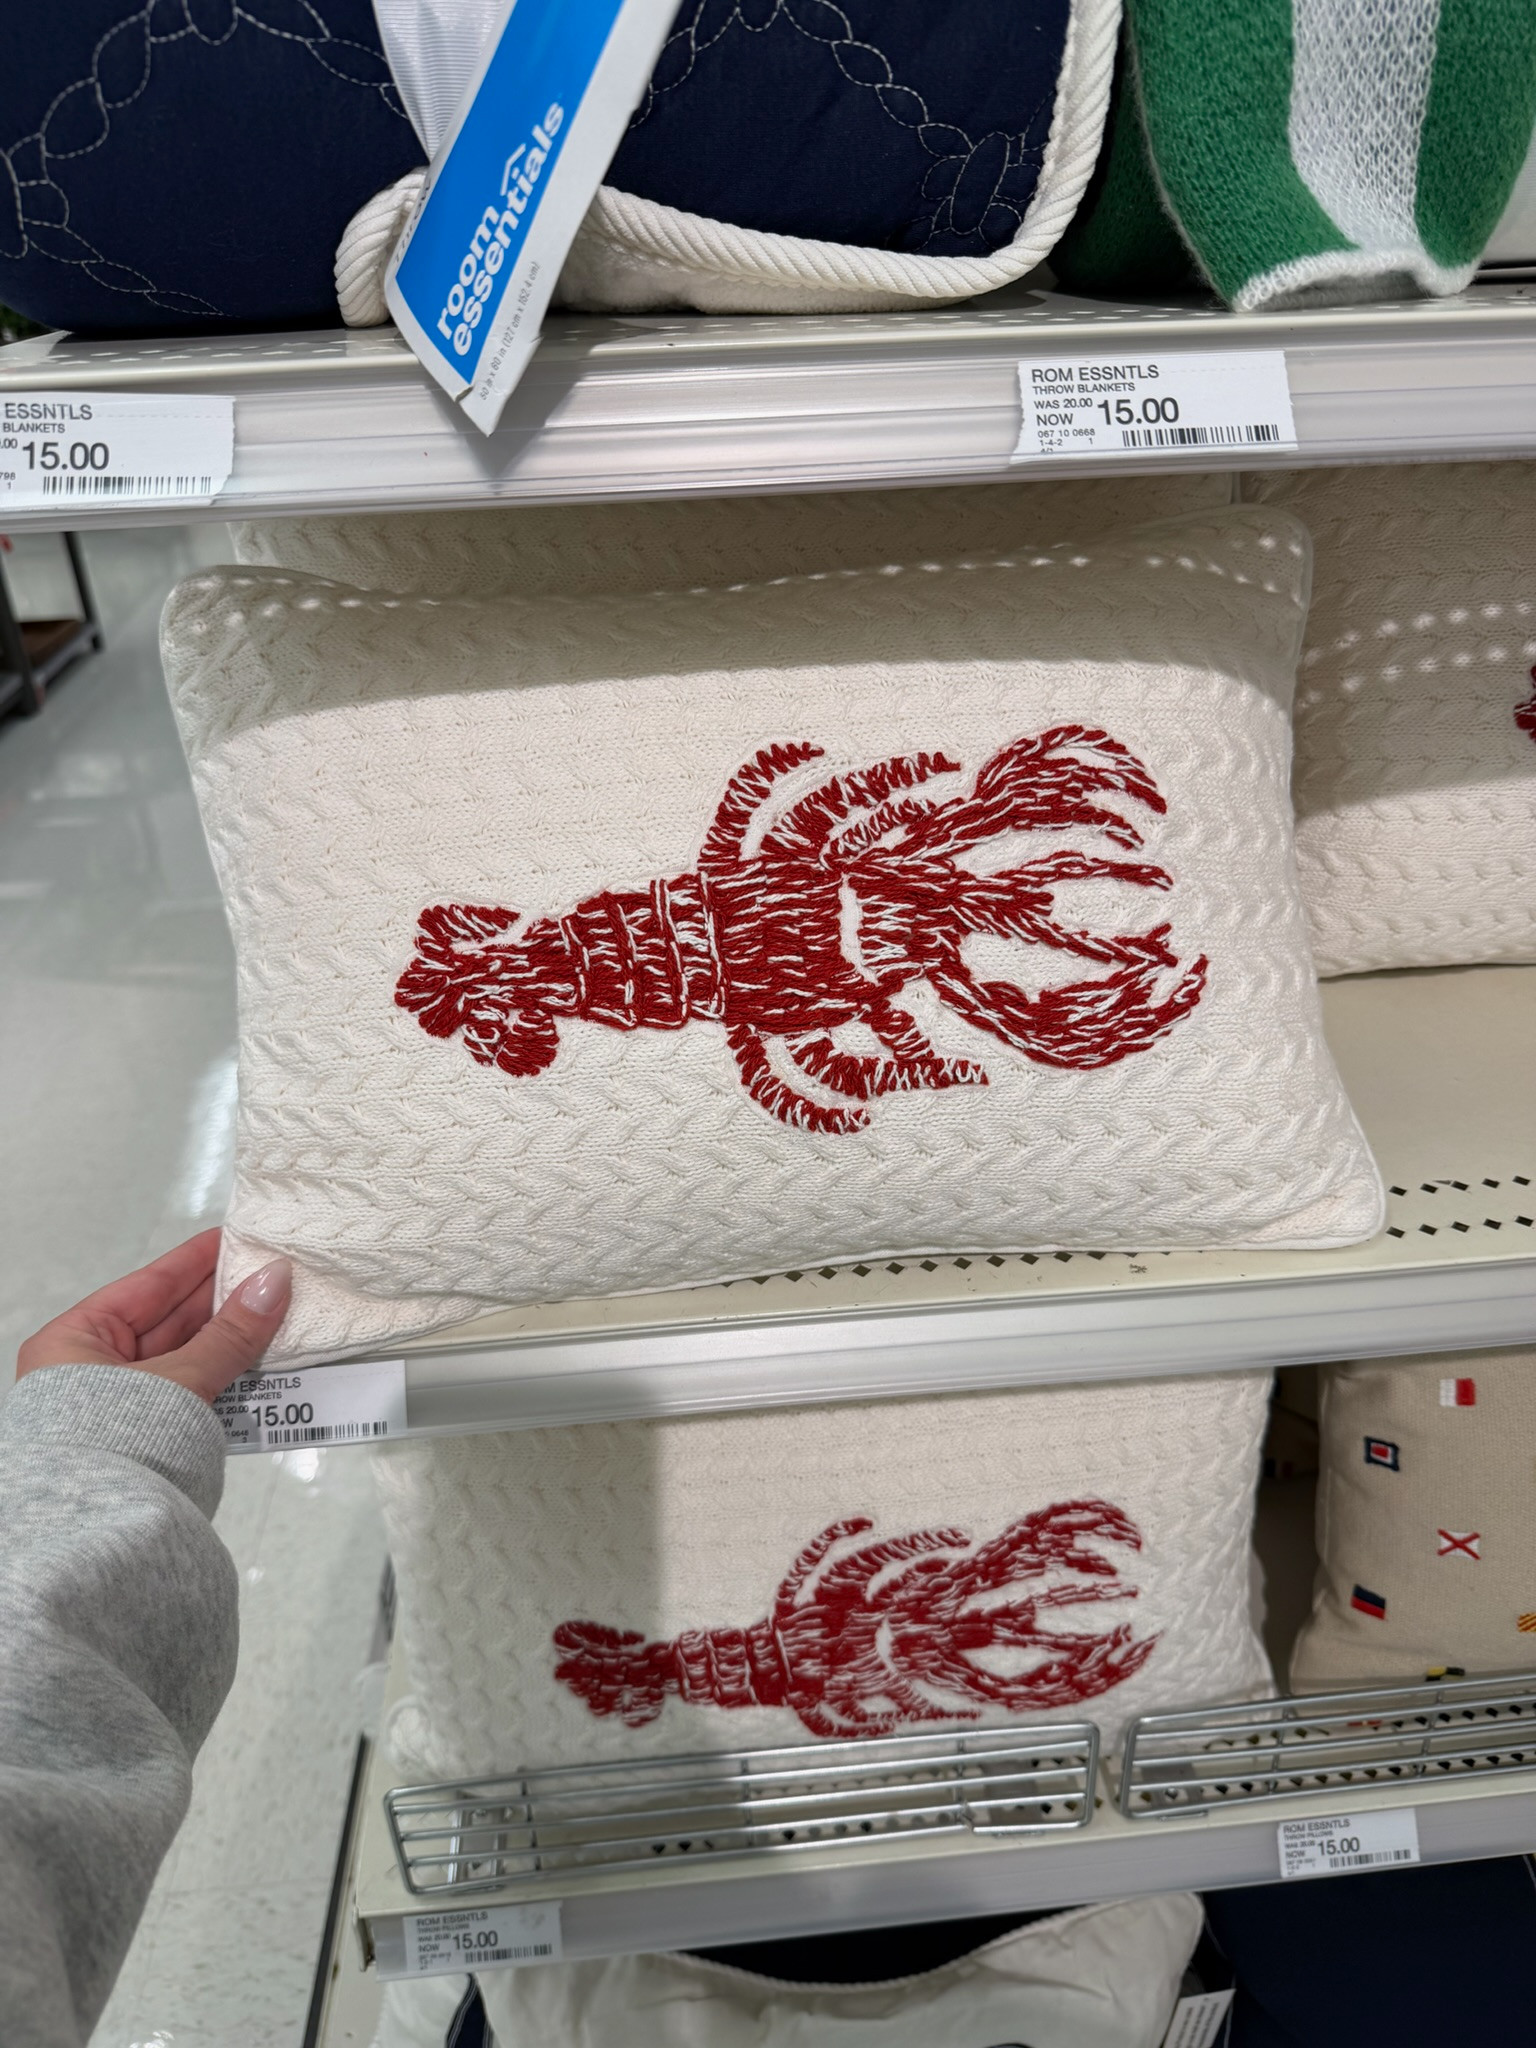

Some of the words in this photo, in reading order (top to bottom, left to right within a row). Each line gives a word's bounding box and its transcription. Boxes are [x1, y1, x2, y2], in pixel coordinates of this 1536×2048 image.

[453, 102, 565, 357] essentials
[436, 205, 500, 341] room
[491, 357, 501, 371] 60
[499, 347, 507, 359] in
[503, 326, 515, 348] (127
[512, 314, 522, 328] cm
[1032, 368, 1073, 382] ROM
[1079, 365, 1159, 380] ESSNTLS
[1033, 385, 1074, 395] THROW
[1078, 382, 1135, 393] BLANKETS
[5, 403, 93, 420] ESSNTLS
[1034, 400, 1060, 409] WAS
[1063, 398, 1093, 408] 20.00
[1036, 414, 1073, 426] NOW
[1097, 397, 1179, 425] 15.00
[3, 423, 65, 433] BLANKETS
[1038, 430, 1054, 438] 067
[1058, 429, 1069, 437] 10
[1072, 428, 1095, 437] 0668
[0, 438, 18, 449] .00
[22, 441, 110, 470] 15.00
[240, 1377, 301, 1392] ESSNTLS
[238, 1392, 282, 1401] BLANKETS
[226, 1405, 249, 1414] 20.00
[252, 1402, 313, 1427] 15.00
[1283, 1823, 1305, 1833] ROM
[1308, 1819, 1350, 1831] ESSNTLS
[1286, 1850, 1305, 1858] NOW
[1317, 1837, 1359, 1856] 15.00
[417, 1917, 440, 1926] ROM
[443, 1911, 488, 1924] ESSNTLS
[452, 1930, 498, 1950] 15.00
